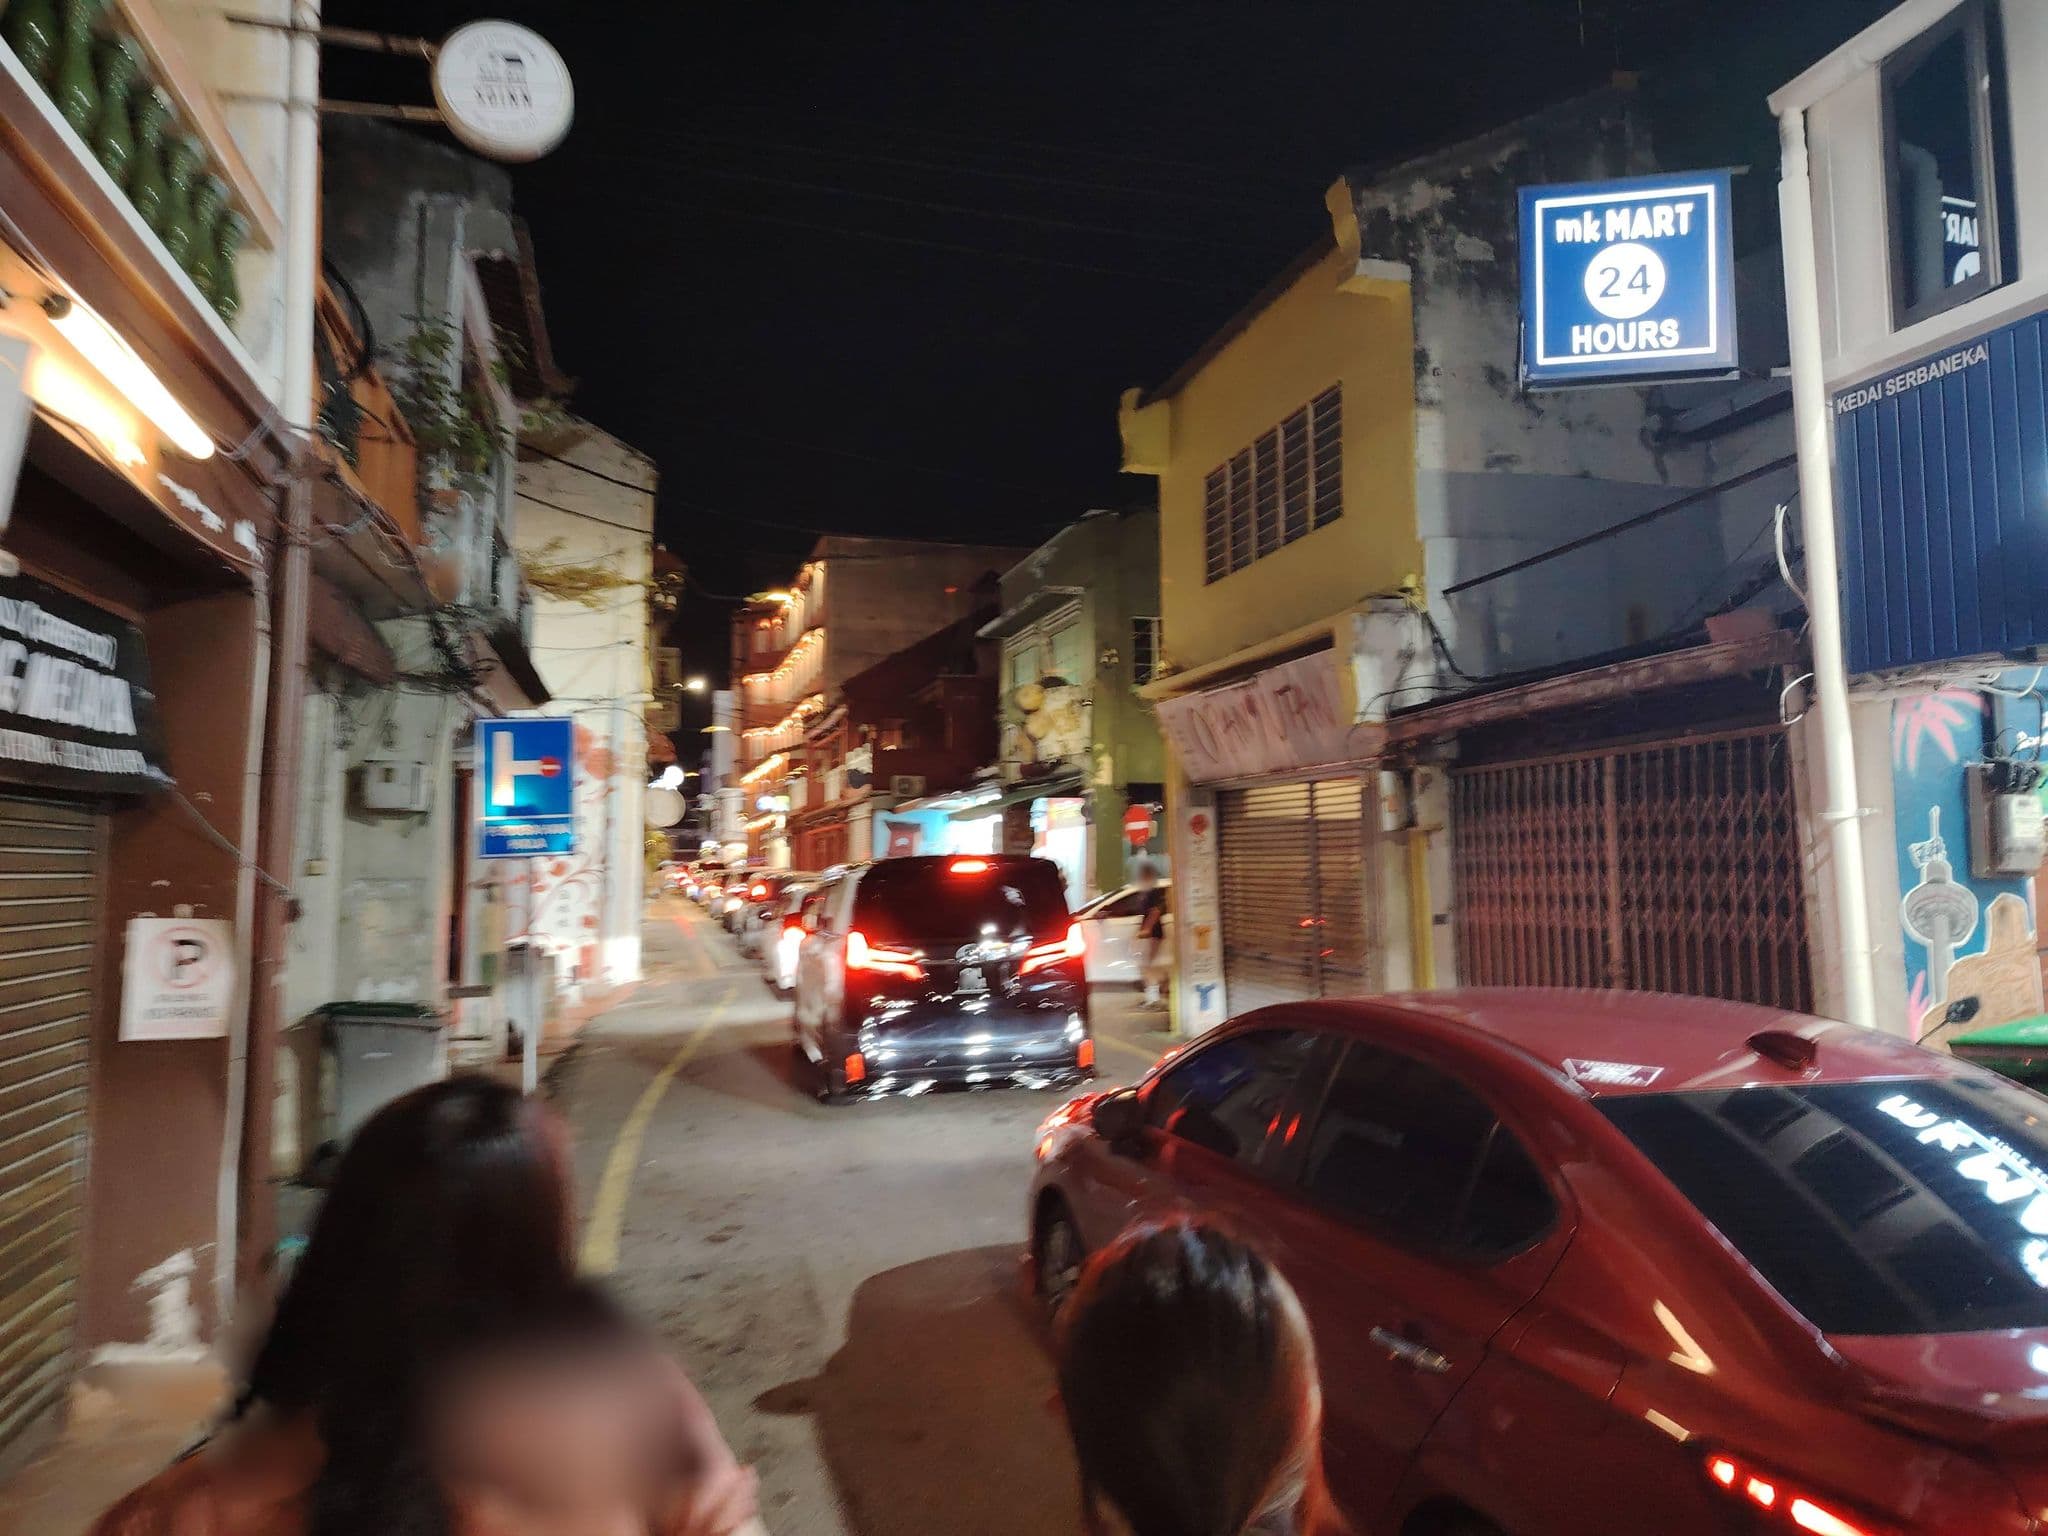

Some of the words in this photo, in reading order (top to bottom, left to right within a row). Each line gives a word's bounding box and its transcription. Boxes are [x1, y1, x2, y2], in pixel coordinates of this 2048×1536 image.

[1555, 211, 1601, 243] mk
[1605, 203, 1693, 241] MART
[1599, 264, 1651, 298] 24
[1571, 319, 1680, 354] HOURS
[1837, 382, 1883, 415] KEDAI
[1885, 344, 1989, 397] SERBANEKA
